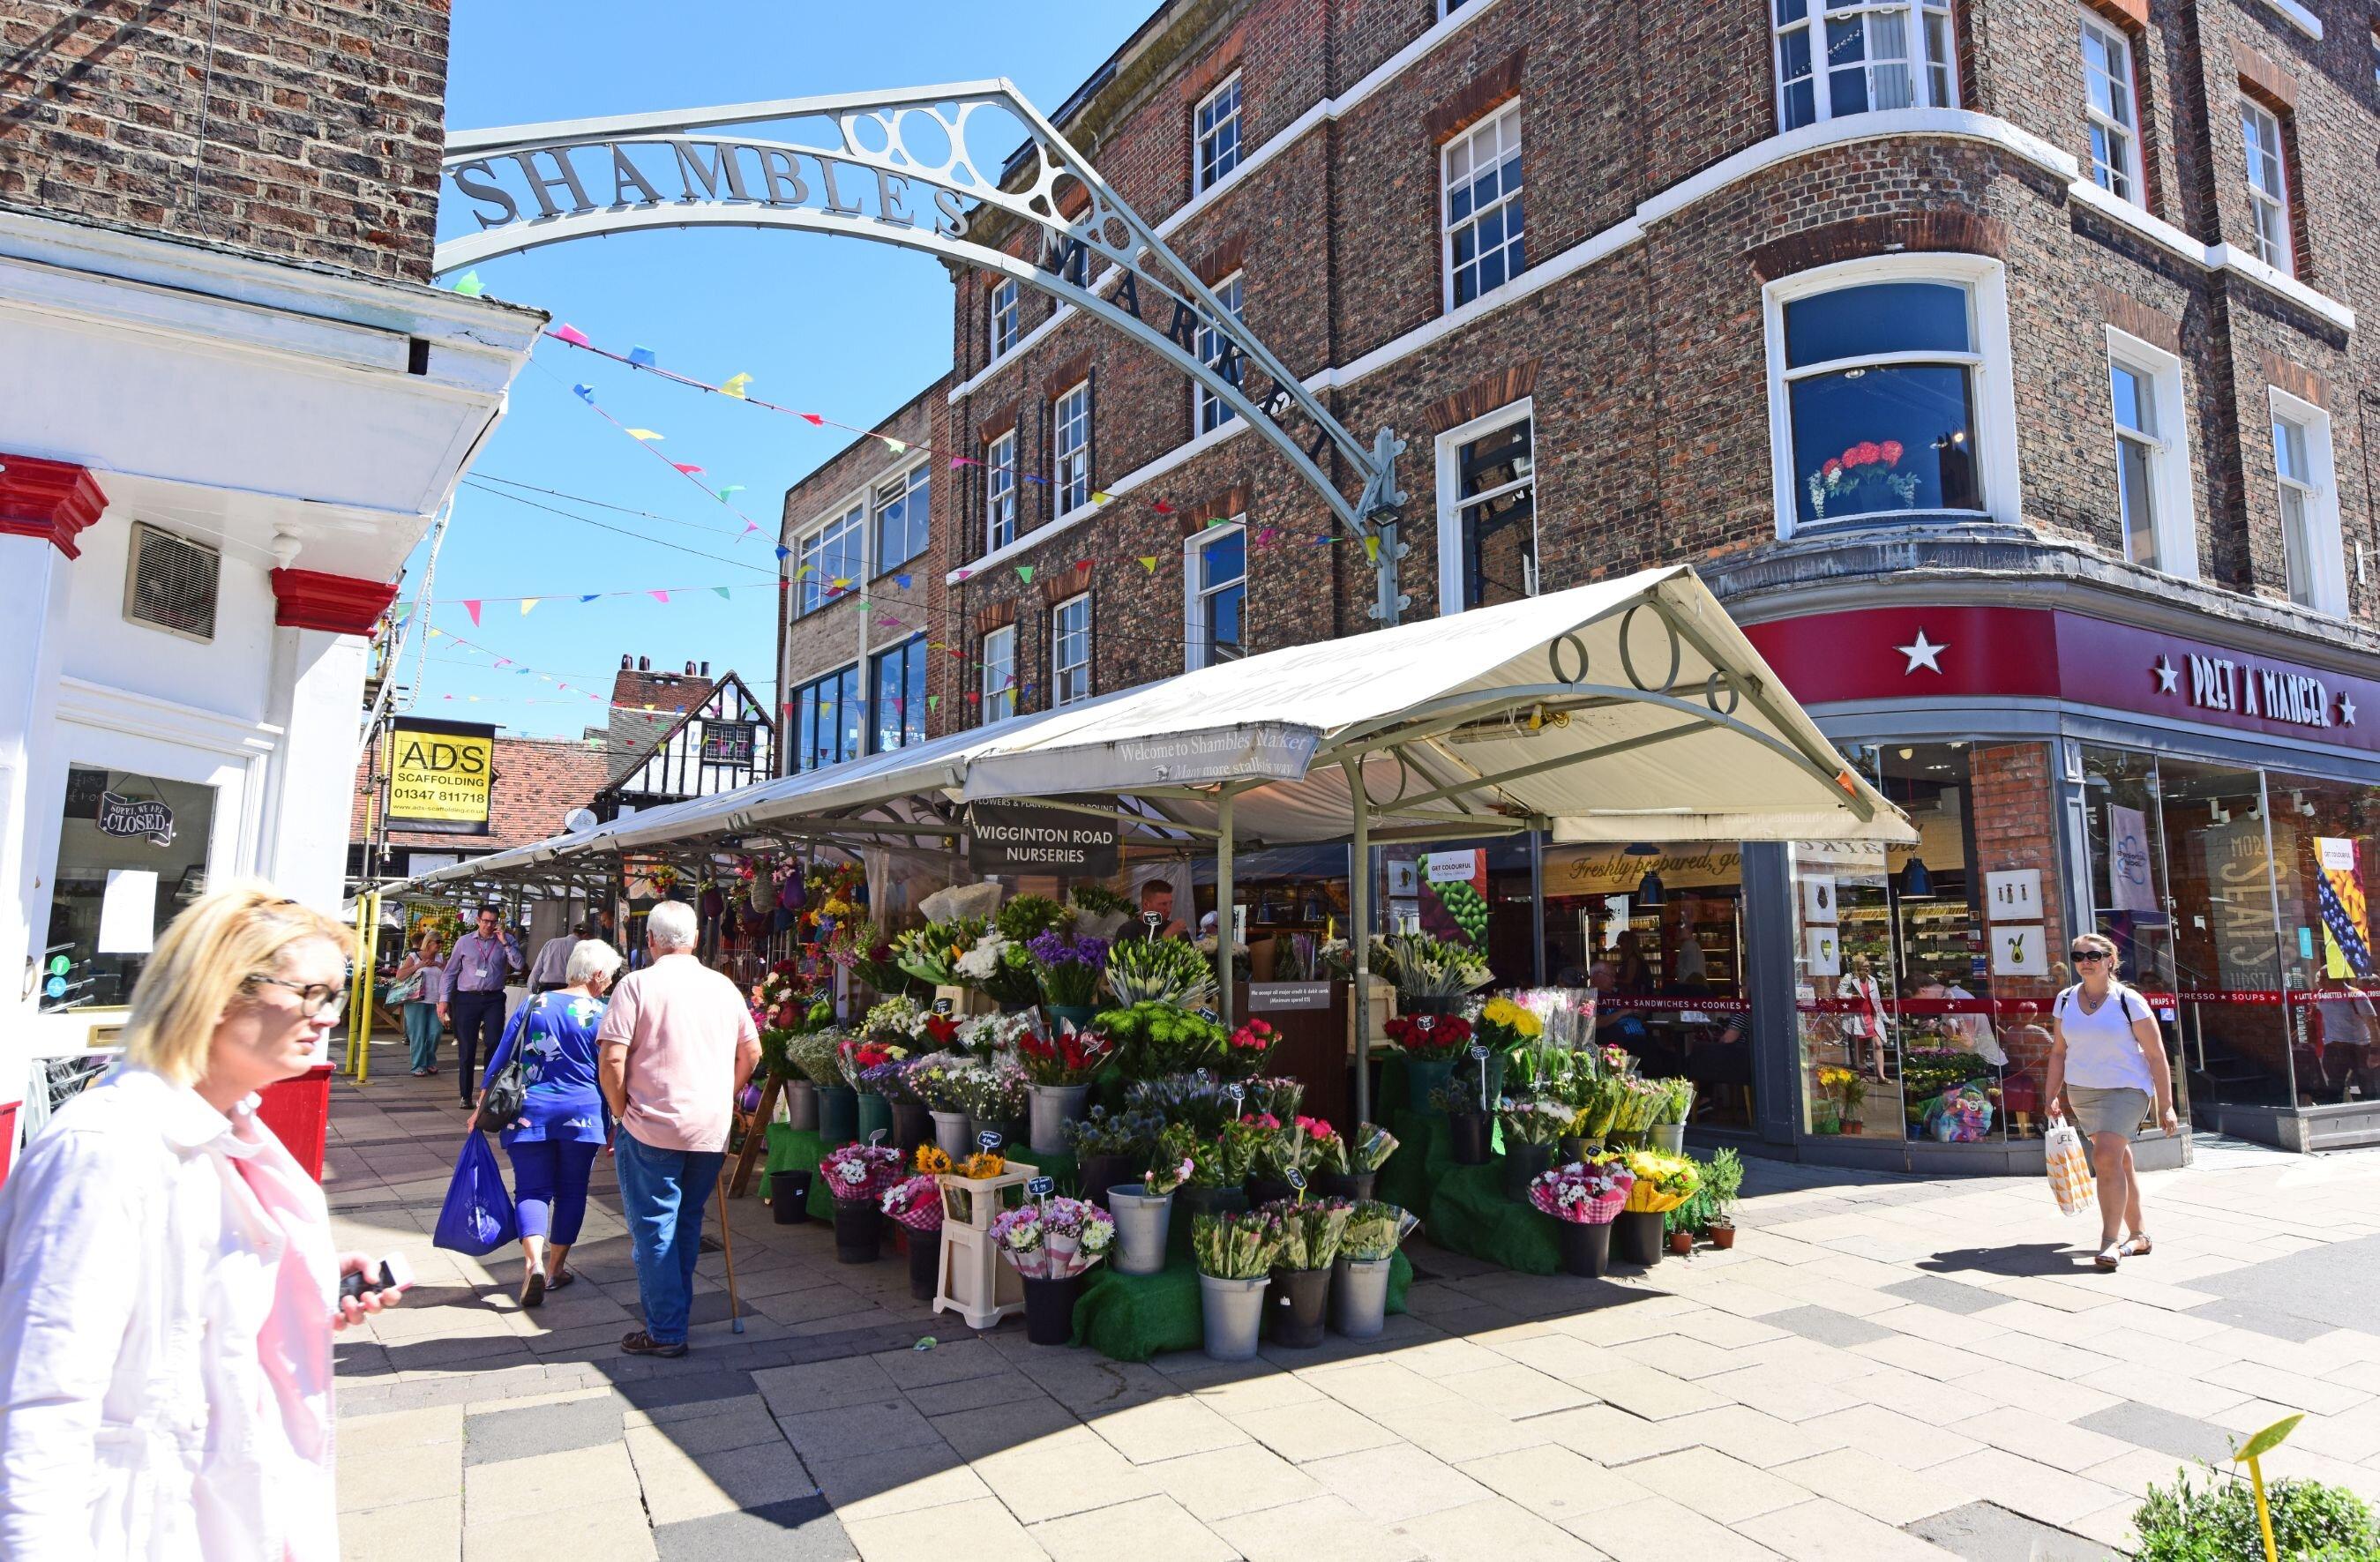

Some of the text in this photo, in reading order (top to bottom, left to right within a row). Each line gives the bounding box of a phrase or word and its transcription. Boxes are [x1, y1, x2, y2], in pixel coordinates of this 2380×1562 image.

[454, 138, 969, 238] SHAMBLES
[1037, 220, 1337, 465] MARKET
[2189, 653, 2331, 728] PRET A MANGER
[1120, 743, 1175, 762] Welcome
[1175, 743, 1188, 756] to
[1191, 731, 1250, 755] Shambles
[400, 741, 484, 774] ADS
[1203, 765, 1230, 777] more
[1273, 762, 1294, 776] way
[398, 773, 484, 788] SCAFFOLDING
[394, 788, 485, 803] 01347 811718
[974, 797, 1011, 807] FLOWERS
[138, 804, 148, 814] WE
[393, 803, 485, 815] www.ads-scaffolding.co.uk
[107, 812, 166, 833] CLOSED
[975, 826, 1113, 844] WIGGINTON ROAD
[1007, 848, 1085, 863] NURSERIES
[2230, 836, 2269, 857] MOR
[1569, 853, 1632, 884] Freshly
[2219, 858, 2298, 967] SEATS
[1634, 998, 1689, 1008] SANDWICHES
[1701, 1001, 1741, 1010] COOKIES
